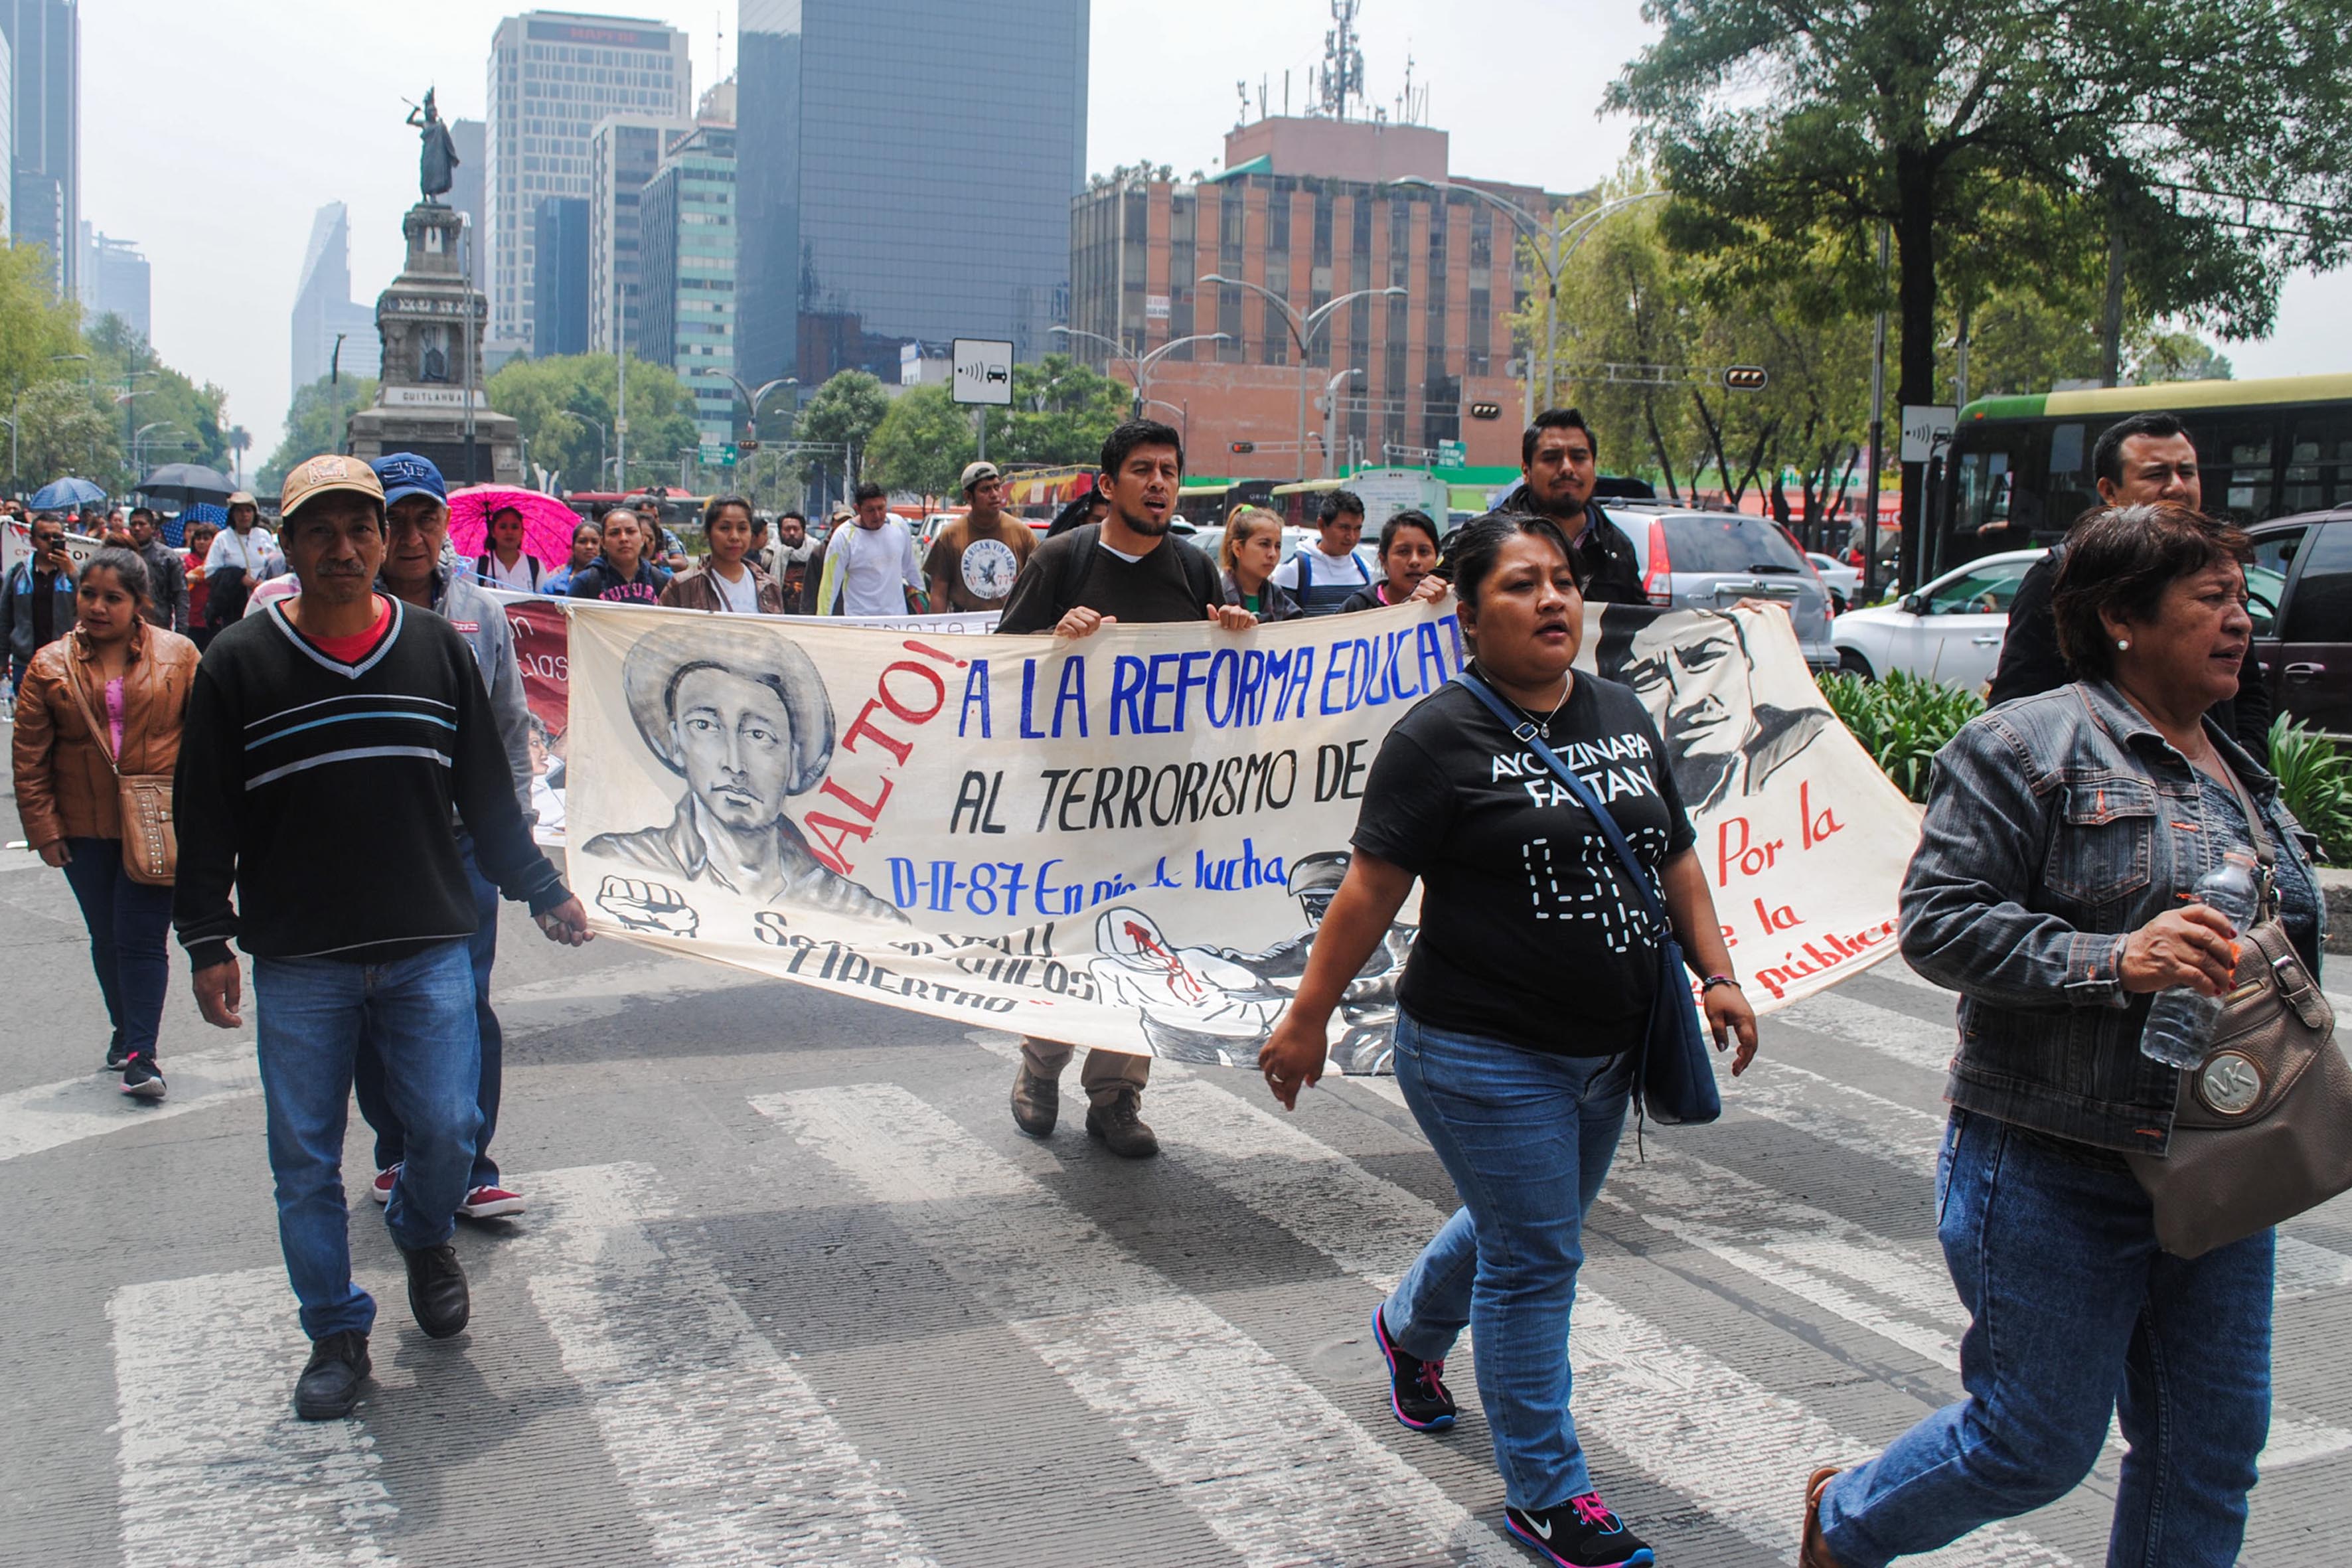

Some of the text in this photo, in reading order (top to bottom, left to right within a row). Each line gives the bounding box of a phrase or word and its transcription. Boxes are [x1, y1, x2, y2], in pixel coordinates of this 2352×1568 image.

[402, 392, 467, 402] CUITLAHUA
[959, 613, 1464, 739] A LA REFORMA EDUCAT
[1492, 733, 1654, 783] AYOZINAPA
[950, 739, 1370, 834] AL TERRORISMO DE
[1524, 765, 1659, 808] FATAN
[1719, 779, 1845, 888] Por la
[1035, 859, 1084, 915] En
[1195, 838, 1289, 892] lucha
[1753, 897, 1806, 935] la
[2205, 1060, 2255, 1101] MK
